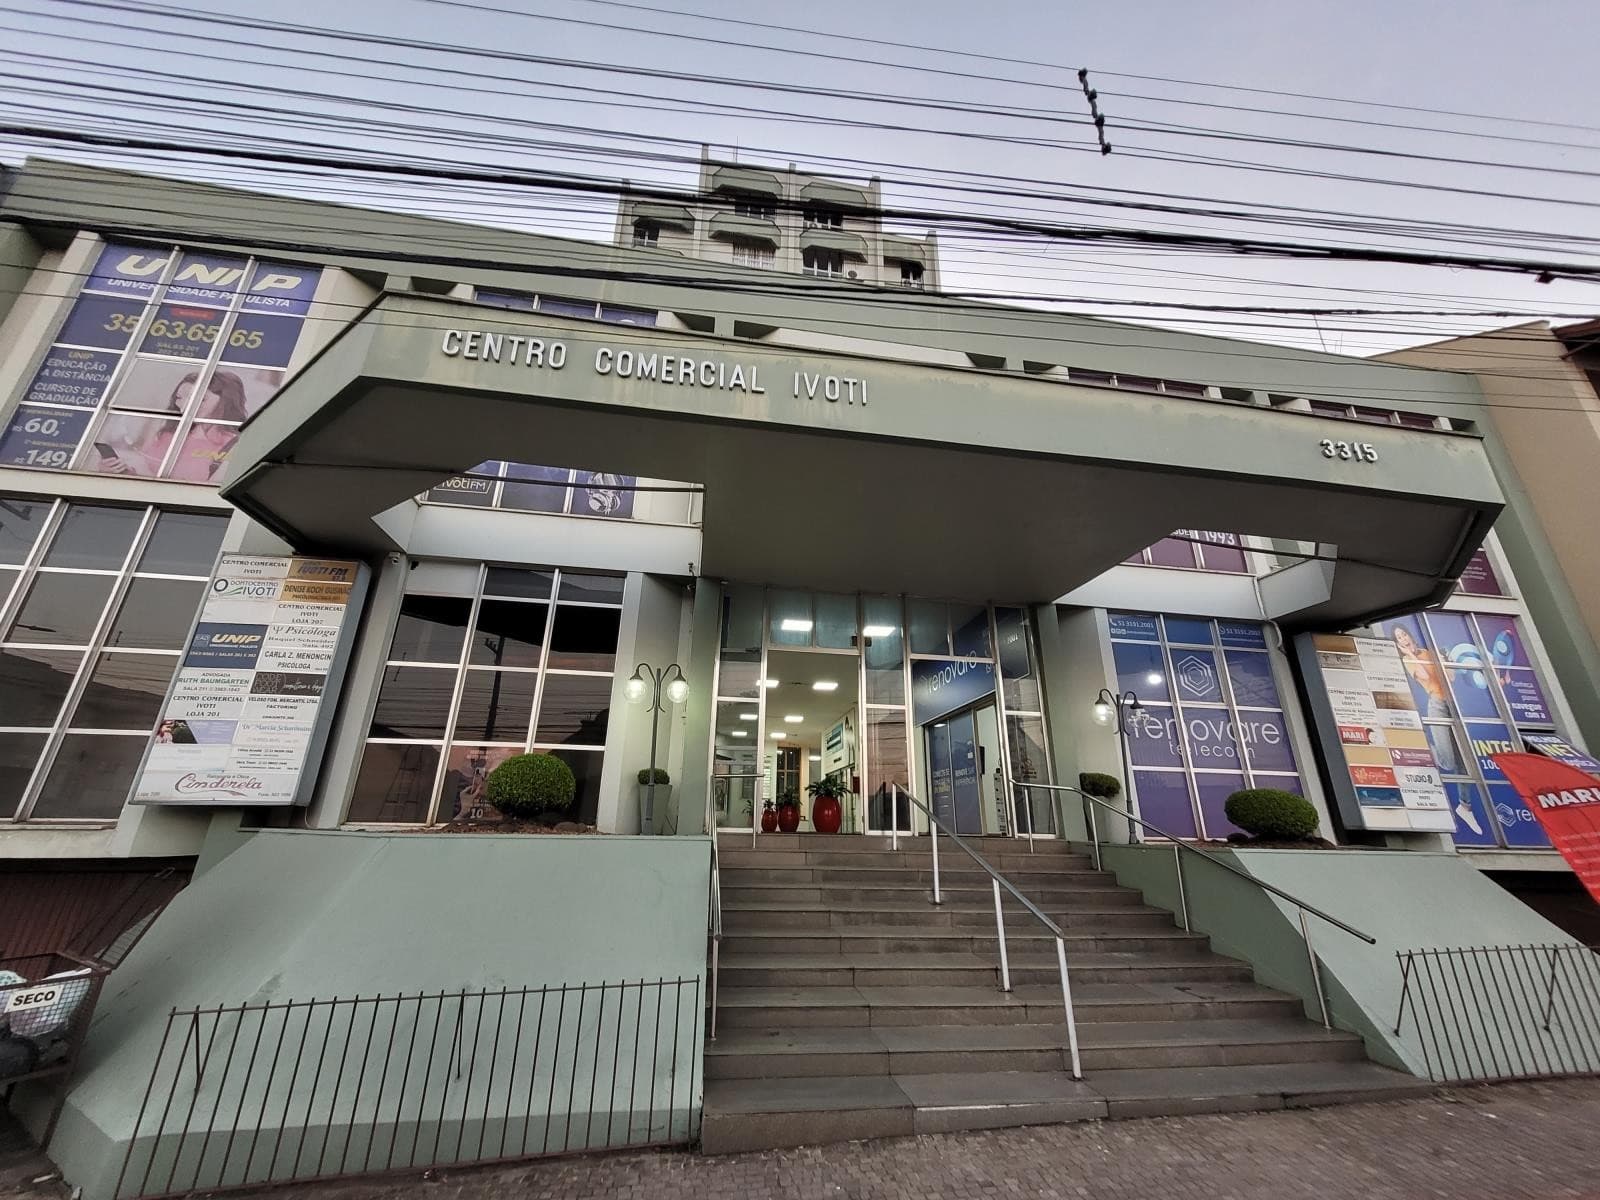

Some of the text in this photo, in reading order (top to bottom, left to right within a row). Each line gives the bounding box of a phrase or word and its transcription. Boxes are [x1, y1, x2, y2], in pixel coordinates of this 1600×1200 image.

[116, 254, 303, 292] UNIP
[46, 359, 108, 371] EDUCAÇÃO
[441, 328, 868, 406] CENTRO COMERCIAL IVOTI
[39, 368, 110, 382] A DISTÂNCIA
[34, 382, 97, 396] CURSOS DE
[29, 391, 100, 405] GRADUAÇÃO
[1320, 438, 1379, 463] 3315
[242, 586, 277, 596] IVOTI
[285, 626, 337, 636] Psicóloga
[210, 633, 262, 644] UNIP
[264, 650, 287, 659] CARLA
[296, 651, 332, 660] MENONCIN
[1511, 702, 1542, 712] navegue
[1168, 740, 1256, 760] telecom
[175, 772, 263, 794] Cinderela
[12, 990, 56, 1007] SECO
